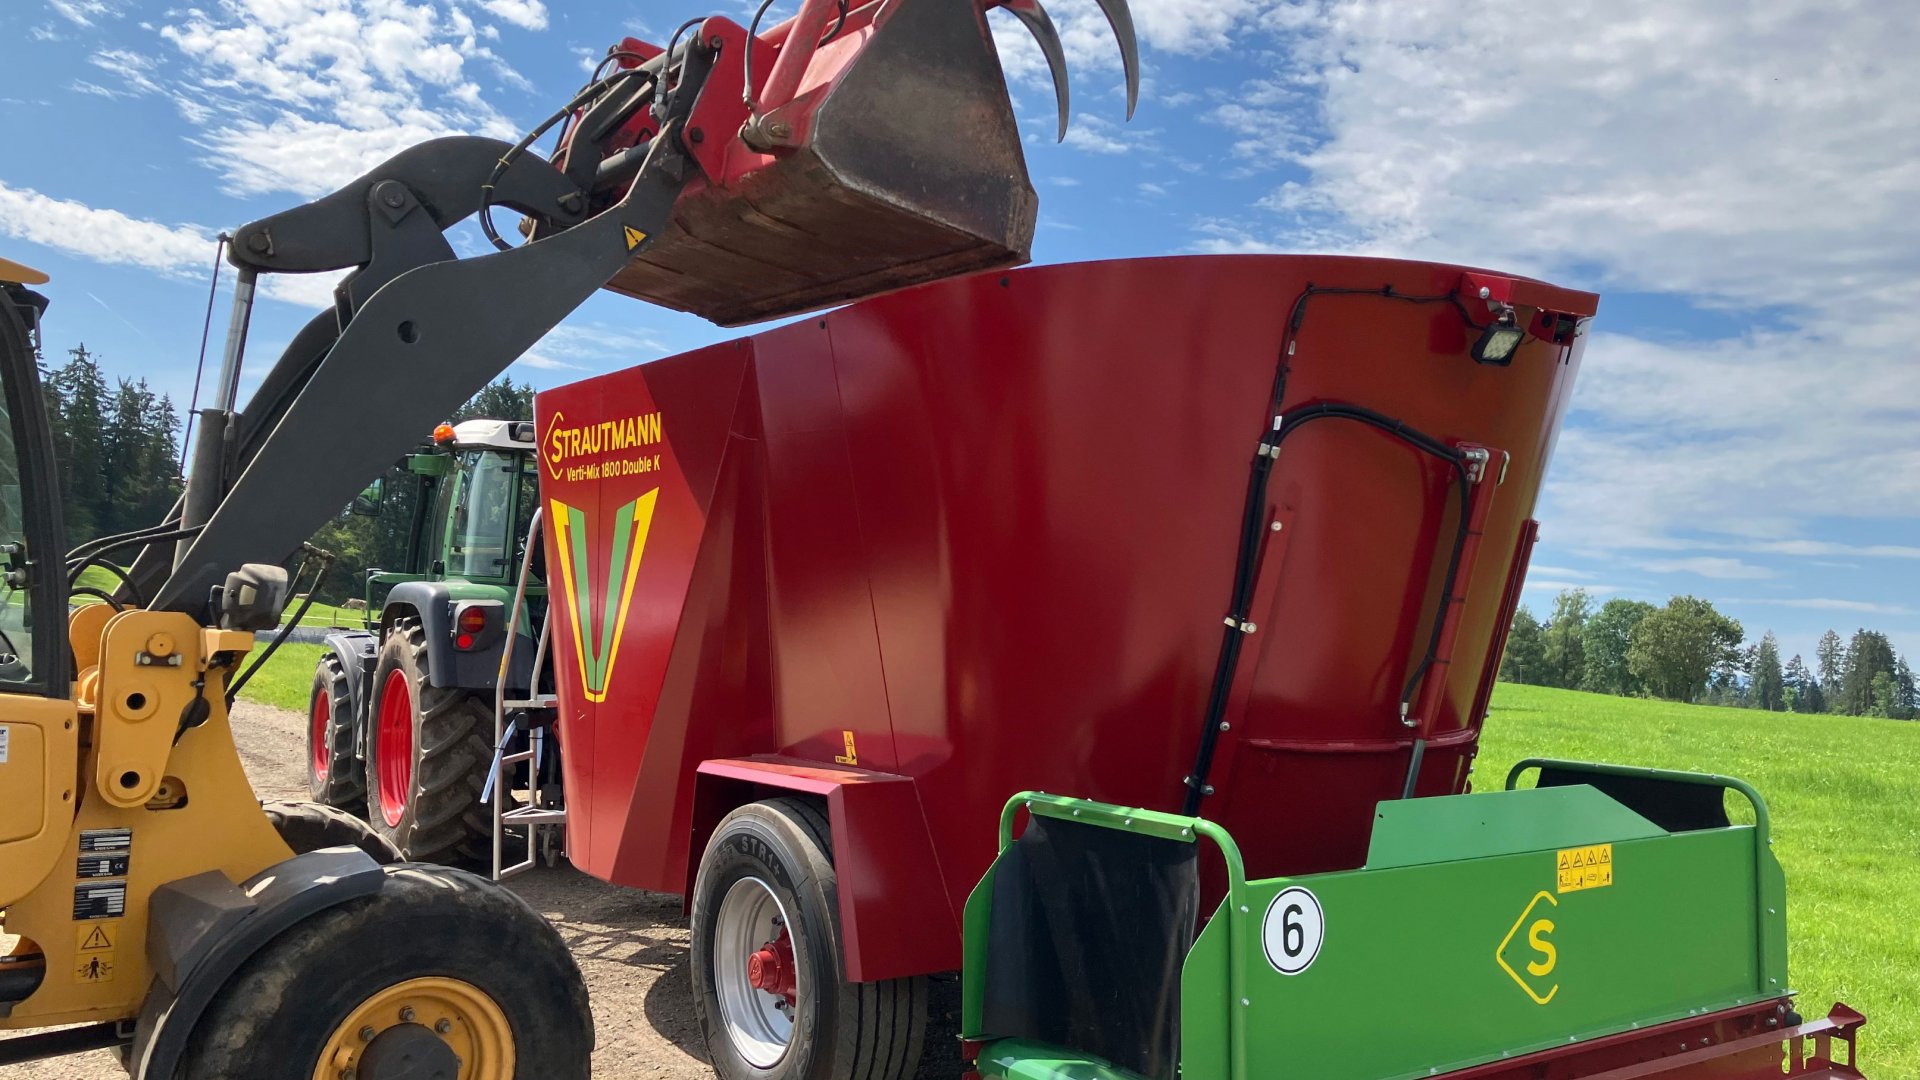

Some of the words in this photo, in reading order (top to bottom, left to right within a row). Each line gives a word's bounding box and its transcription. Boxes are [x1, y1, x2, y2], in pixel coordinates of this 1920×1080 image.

[551, 411, 662, 464] STRAUTMANN
[566, 463, 600, 482] Verti-Mix
[602, 460, 620, 478] 1800
[622, 455, 652, 476] Double
[654, 454, 661, 471] K
[1282, 903, 1304, 958] 6
[1526, 918, 1557, 977] S
